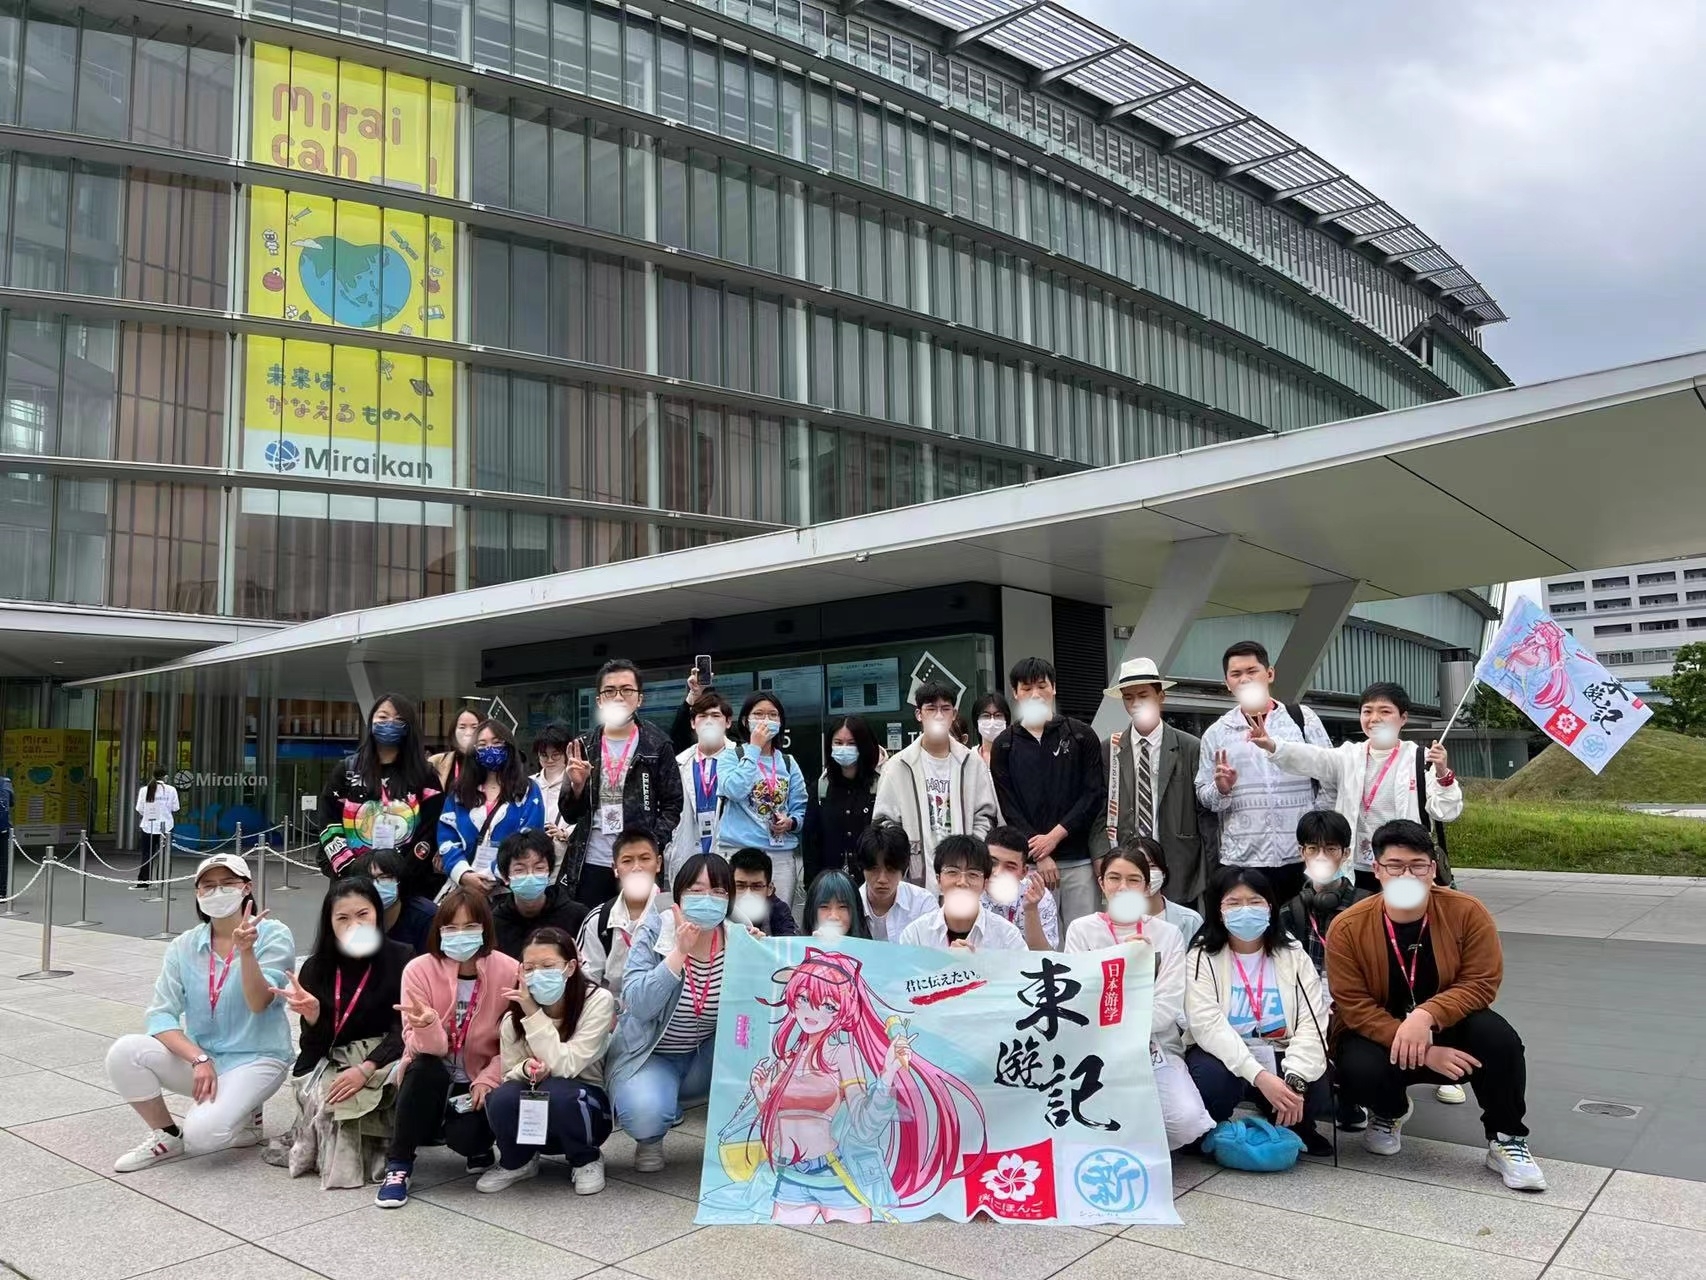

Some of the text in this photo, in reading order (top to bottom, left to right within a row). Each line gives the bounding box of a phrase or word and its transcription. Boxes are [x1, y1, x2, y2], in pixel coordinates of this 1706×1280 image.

[304, 447, 433, 480] Miraikan
[196, 772, 268, 787] Miraikan
[905, 969, 982, 993] 君に伝えたい。
[1104, 962, 1120, 1022] 日本游学
[1079, 1152, 1143, 1212] 新
